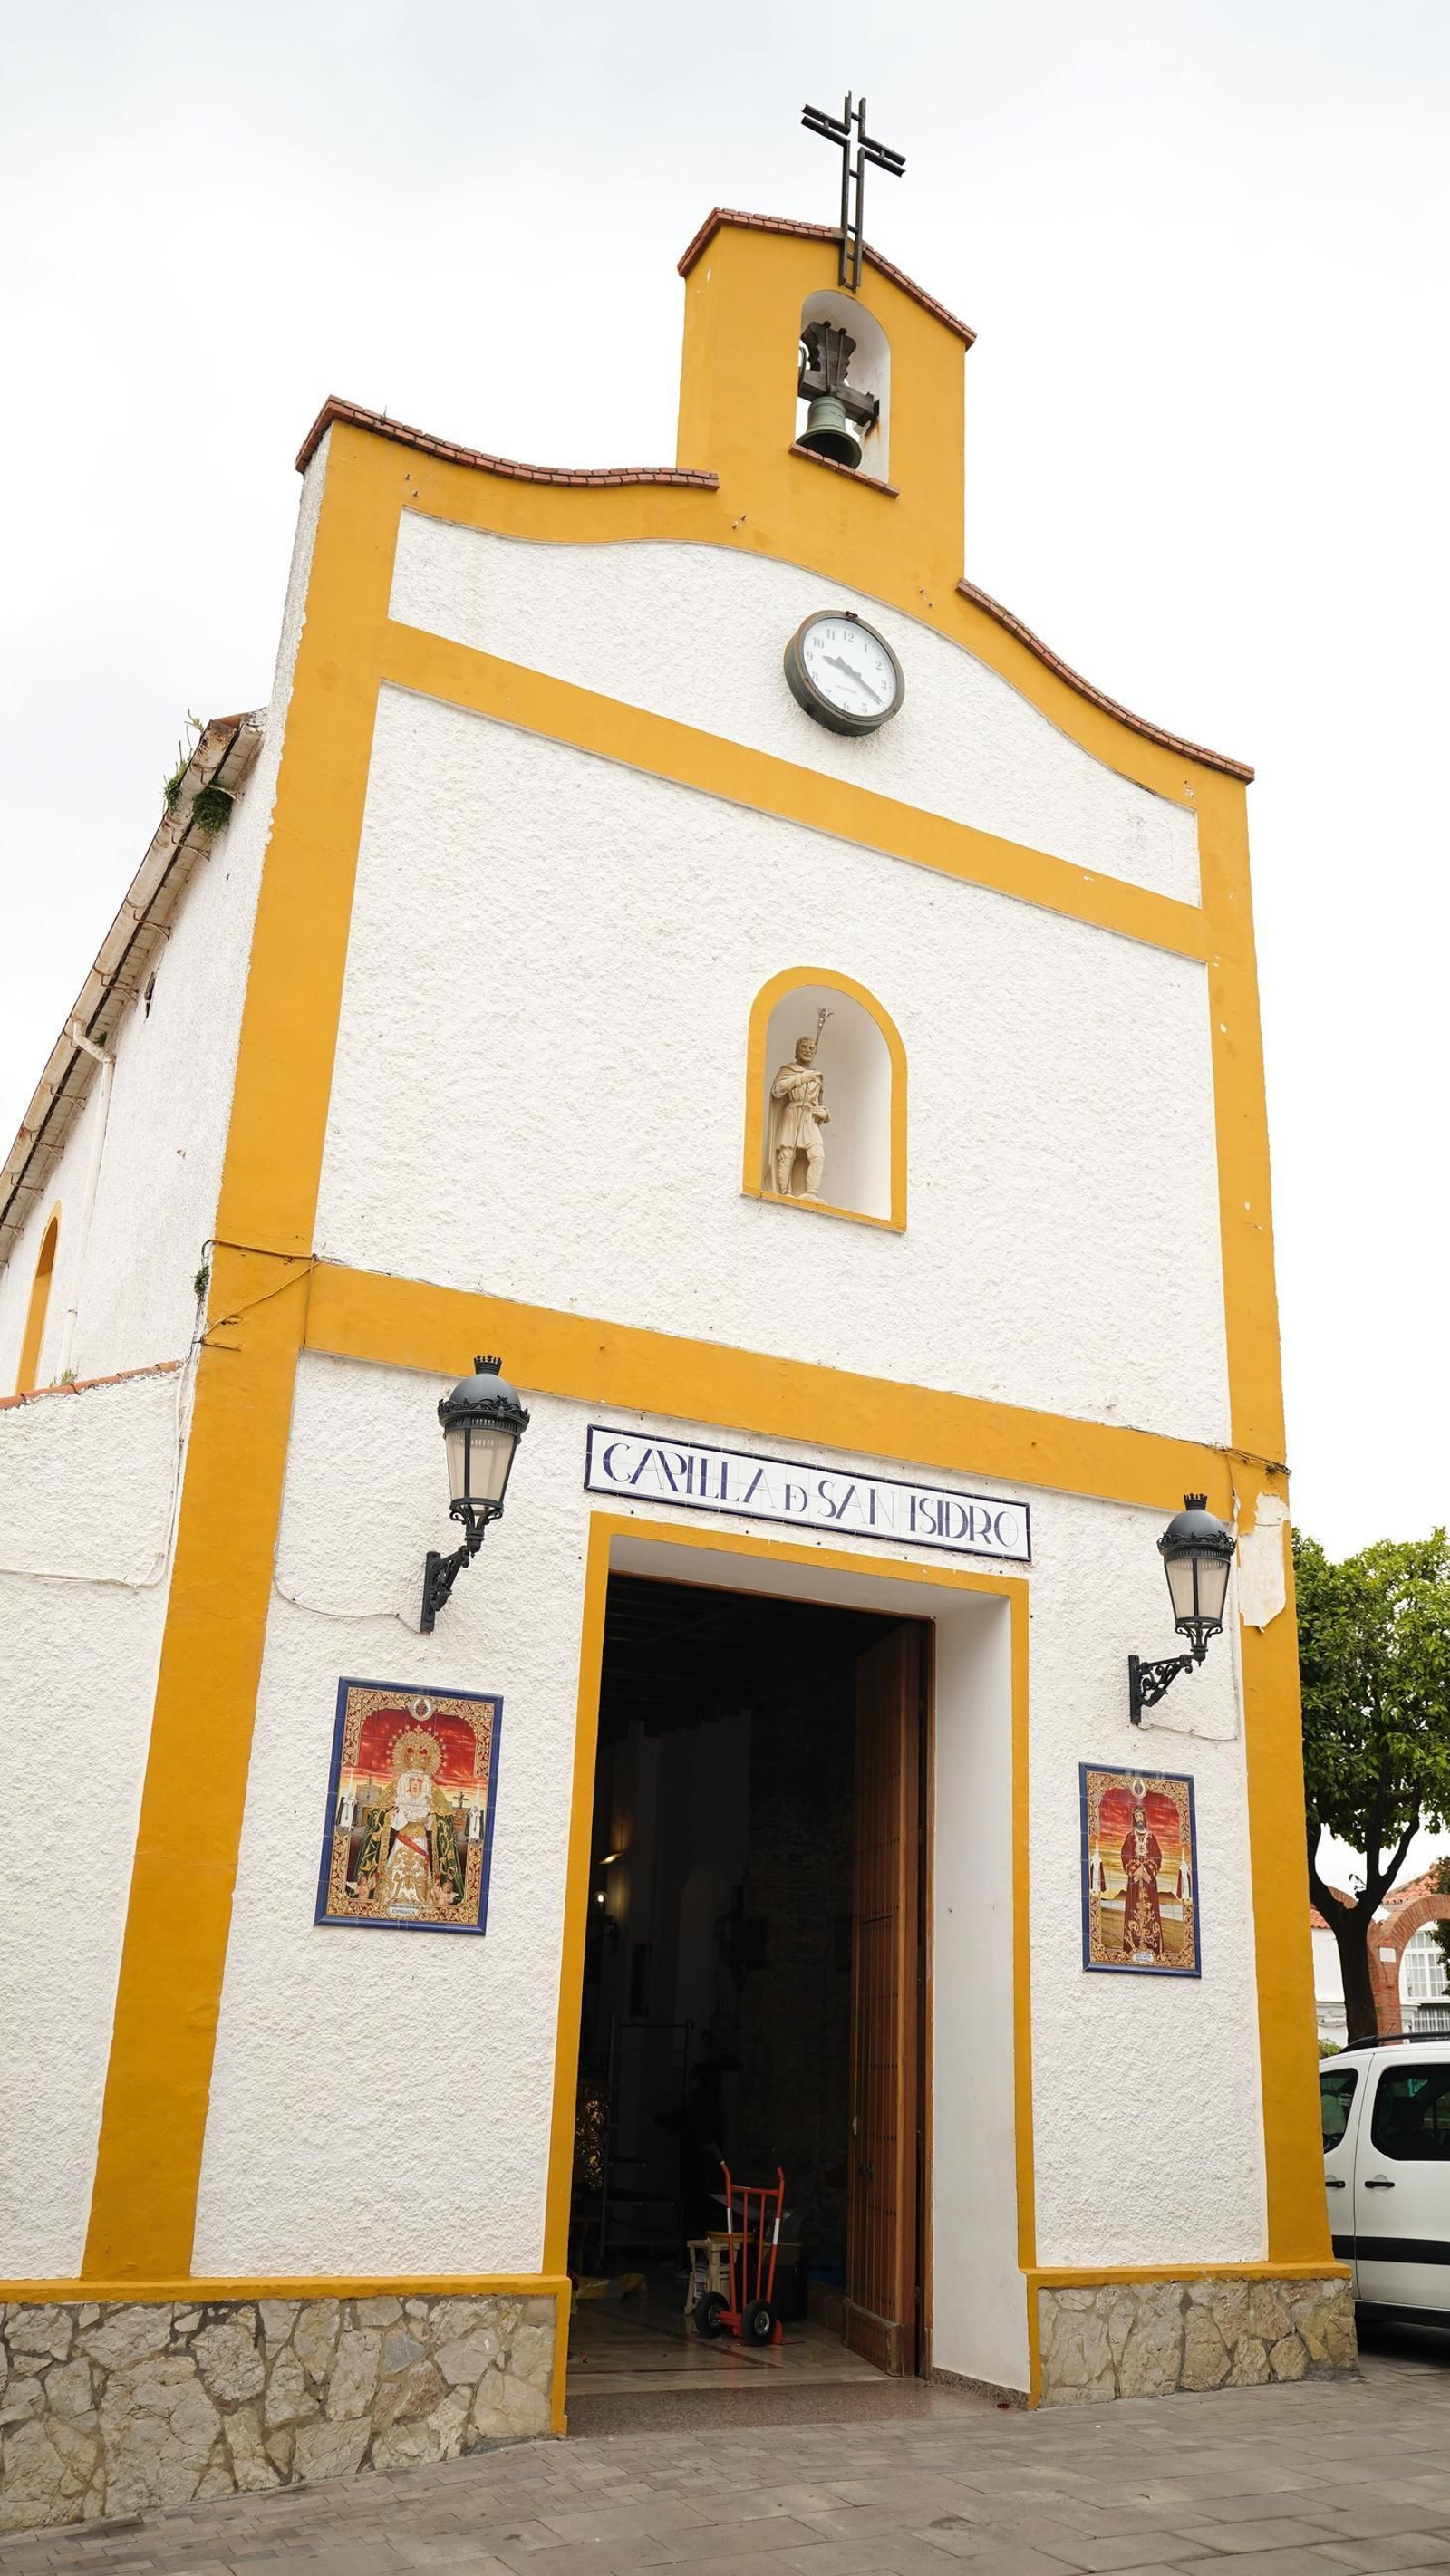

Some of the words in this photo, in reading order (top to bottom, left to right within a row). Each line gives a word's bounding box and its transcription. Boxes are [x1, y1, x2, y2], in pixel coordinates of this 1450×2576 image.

[826, 628, 836, 641] 11
[843, 630, 855, 642] 12
[814, 637, 825, 649] 10
[807, 651, 814, 661] 9
[875, 661, 883, 671] 2
[881, 680, 887, 690] 3
[843, 700, 850, 711] 6
[861, 702, 868, 713] 5
[603, 1442, 777, 1509] CAPILLA
[817, 1480, 895, 1529] SAN
[907, 1494, 1019, 1548] ISIDRO
